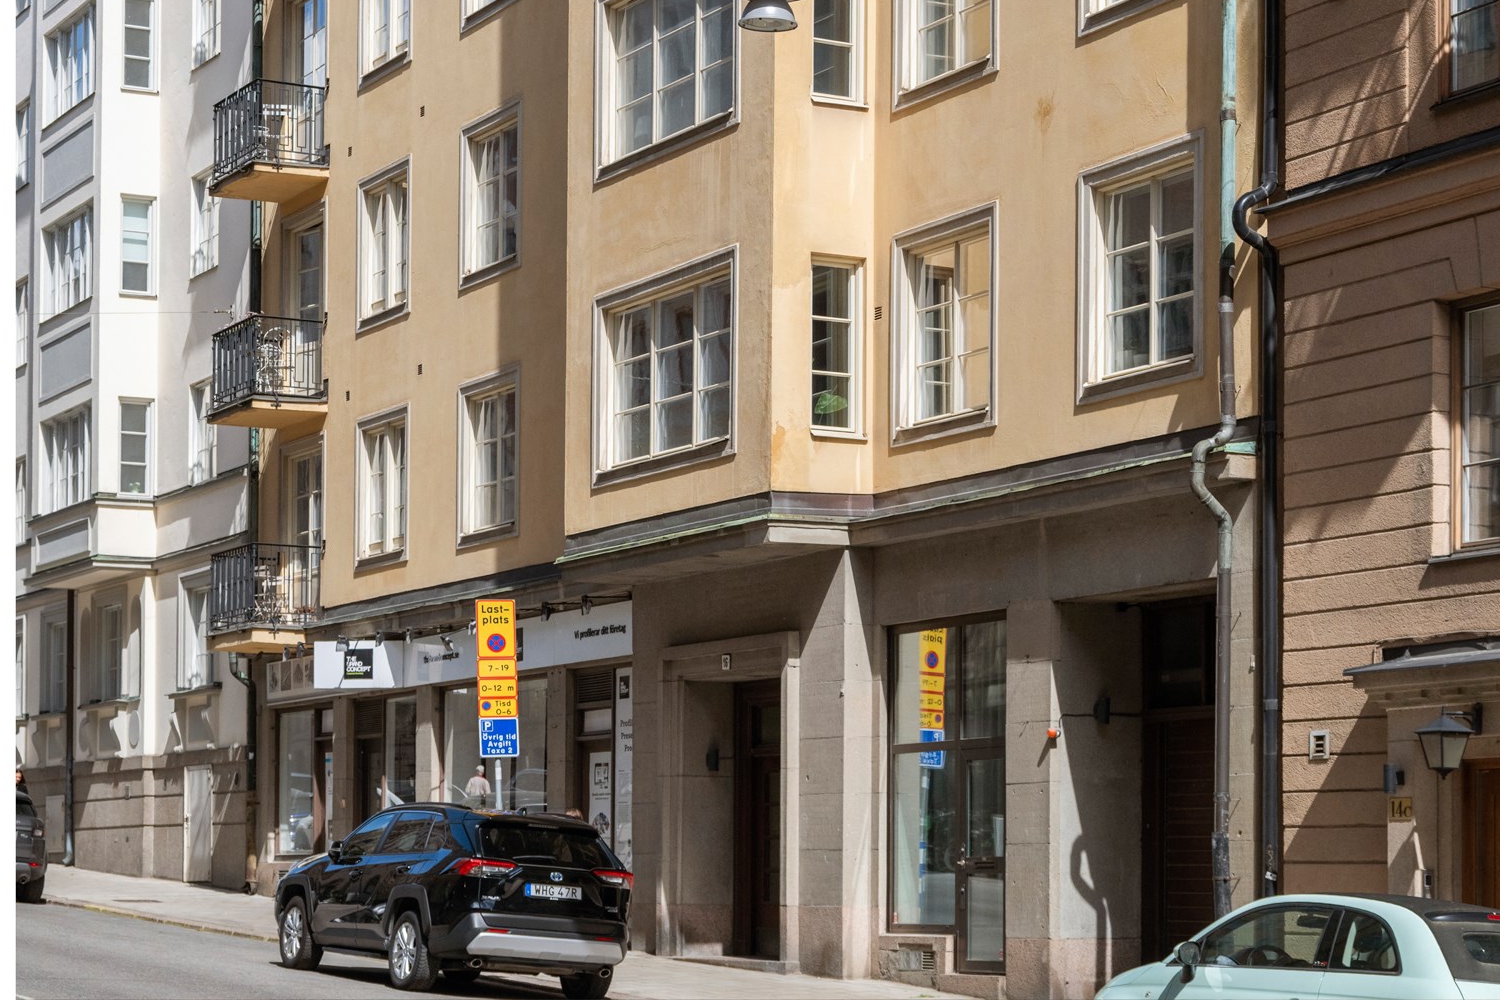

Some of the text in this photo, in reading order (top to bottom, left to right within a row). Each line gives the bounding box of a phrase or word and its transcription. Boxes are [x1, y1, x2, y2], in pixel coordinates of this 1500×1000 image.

[481, 604, 510, 614] Last-
[482, 615, 509, 626] plats
[573, 630, 579, 640] Vi
[481, 684, 502, 692] 0-12
[484, 721, 492, 731] P
[482, 732, 504, 741] Övrig
[487, 740, 512, 748] Avgift
[534, 884, 577, 898] WHG 47R
